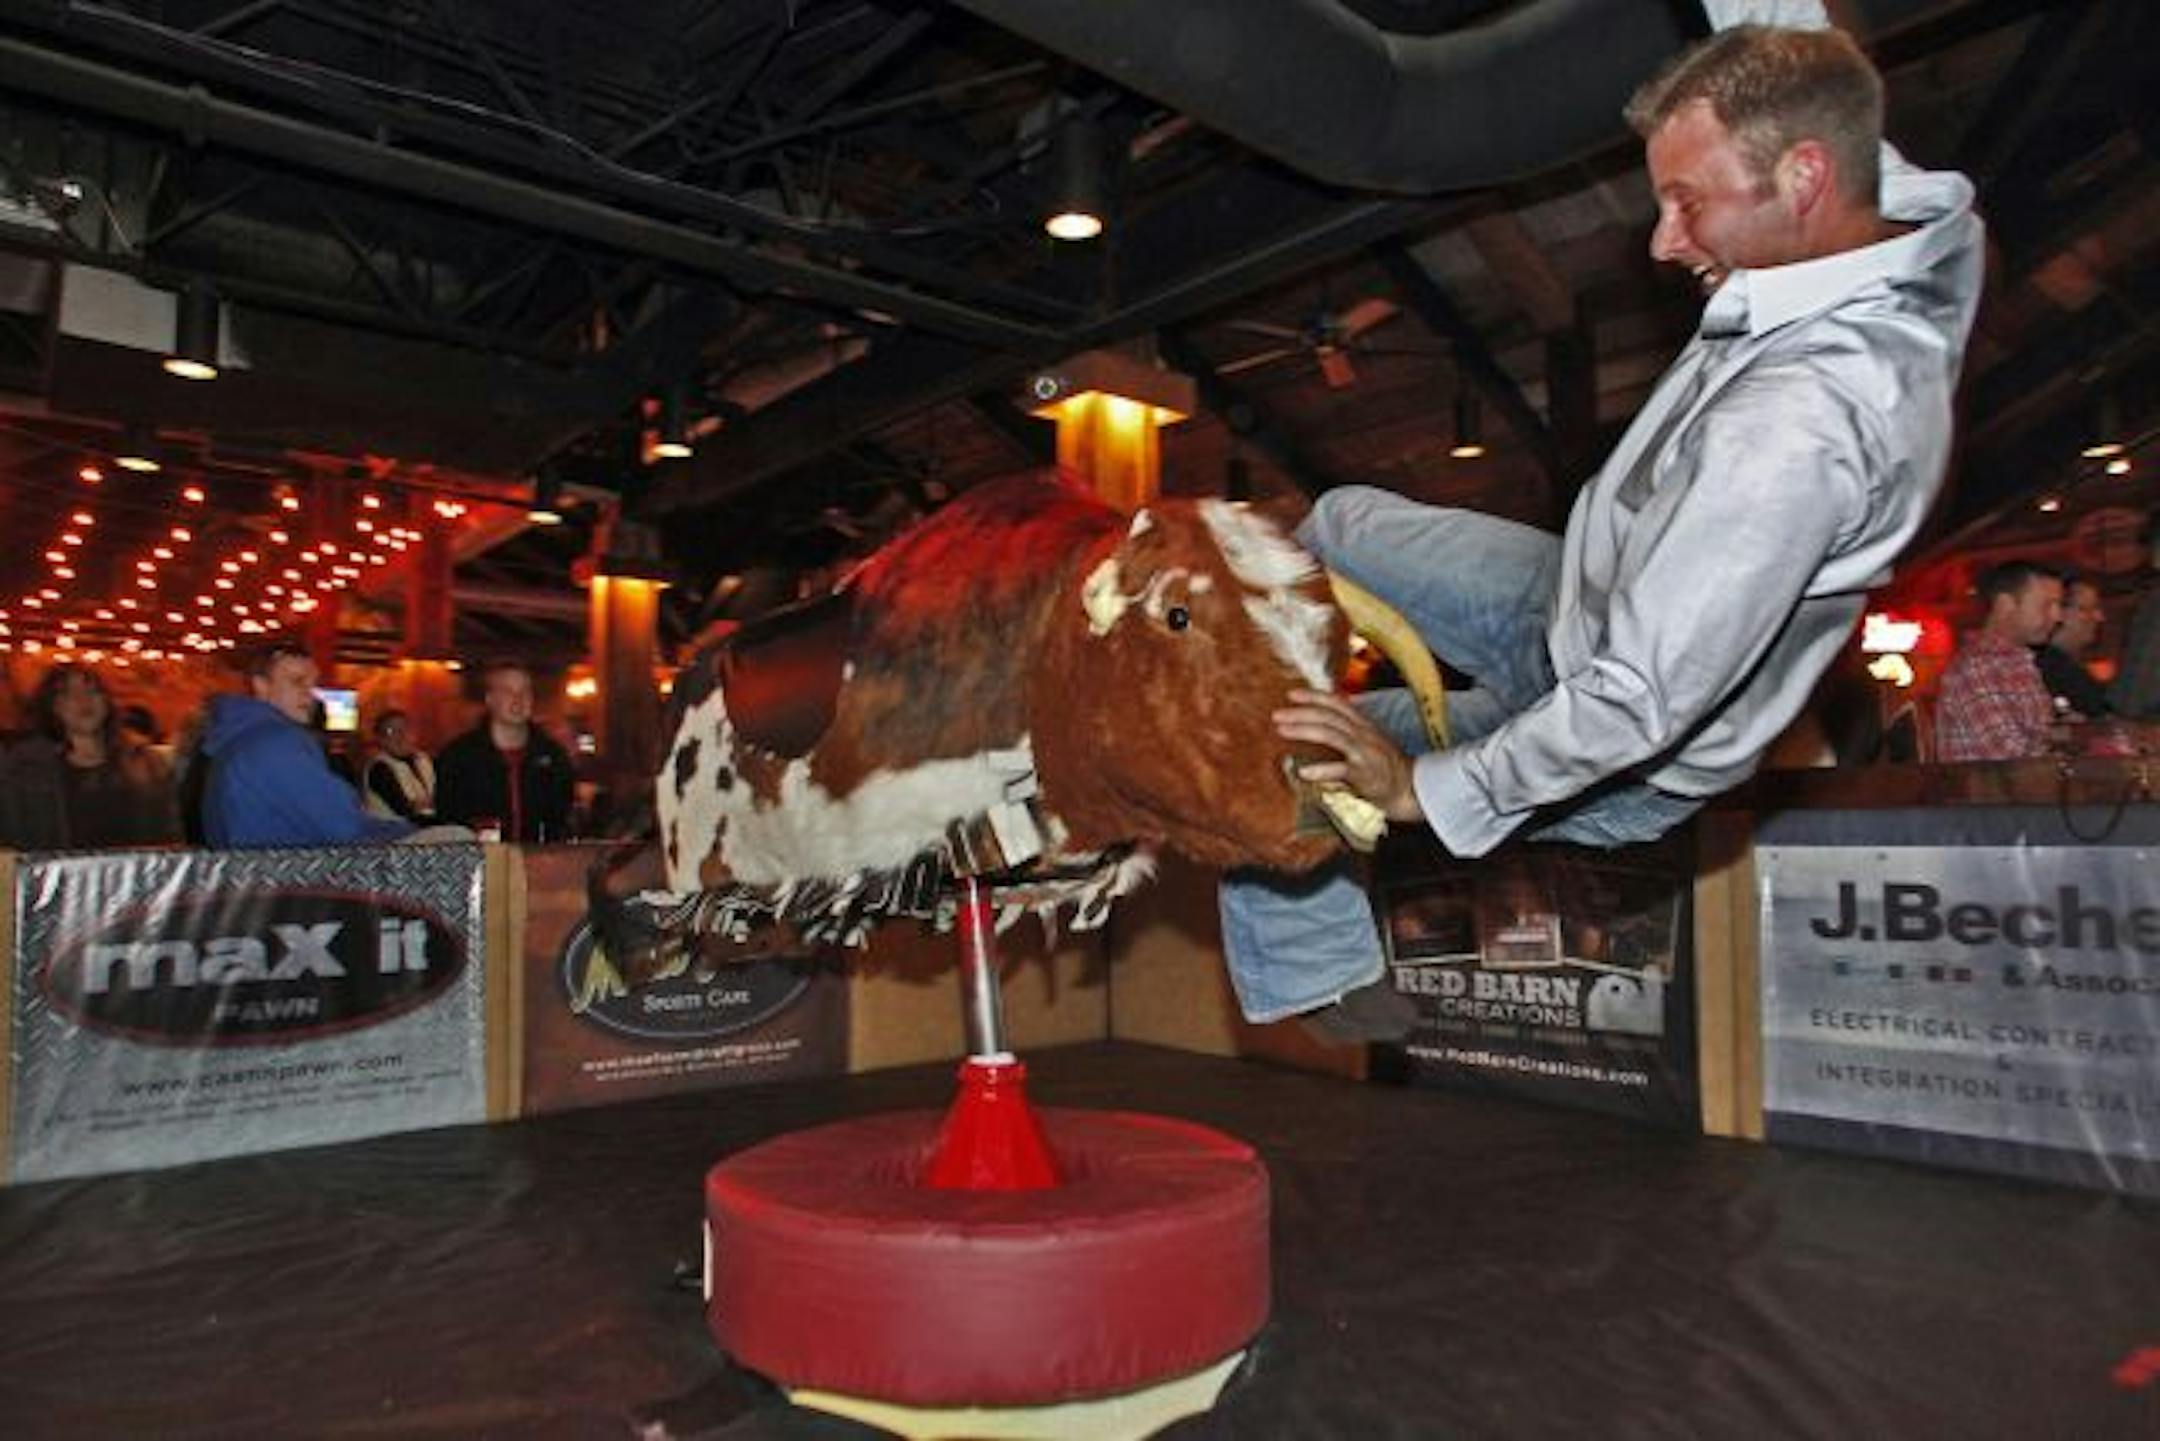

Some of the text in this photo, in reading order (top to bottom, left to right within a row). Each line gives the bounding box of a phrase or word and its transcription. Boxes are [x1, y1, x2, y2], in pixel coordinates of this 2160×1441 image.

[378, 917, 430, 974] it
[1395, 967, 1580, 1007] RED BARN
[215, 998, 318, 1021] PAWN
[1440, 998, 1581, 1027] CREATIONS
[1811, 1009, 1976, 1040] ELECTRICAL
[1817, 1062, 2000, 1098] INTEGRATION
